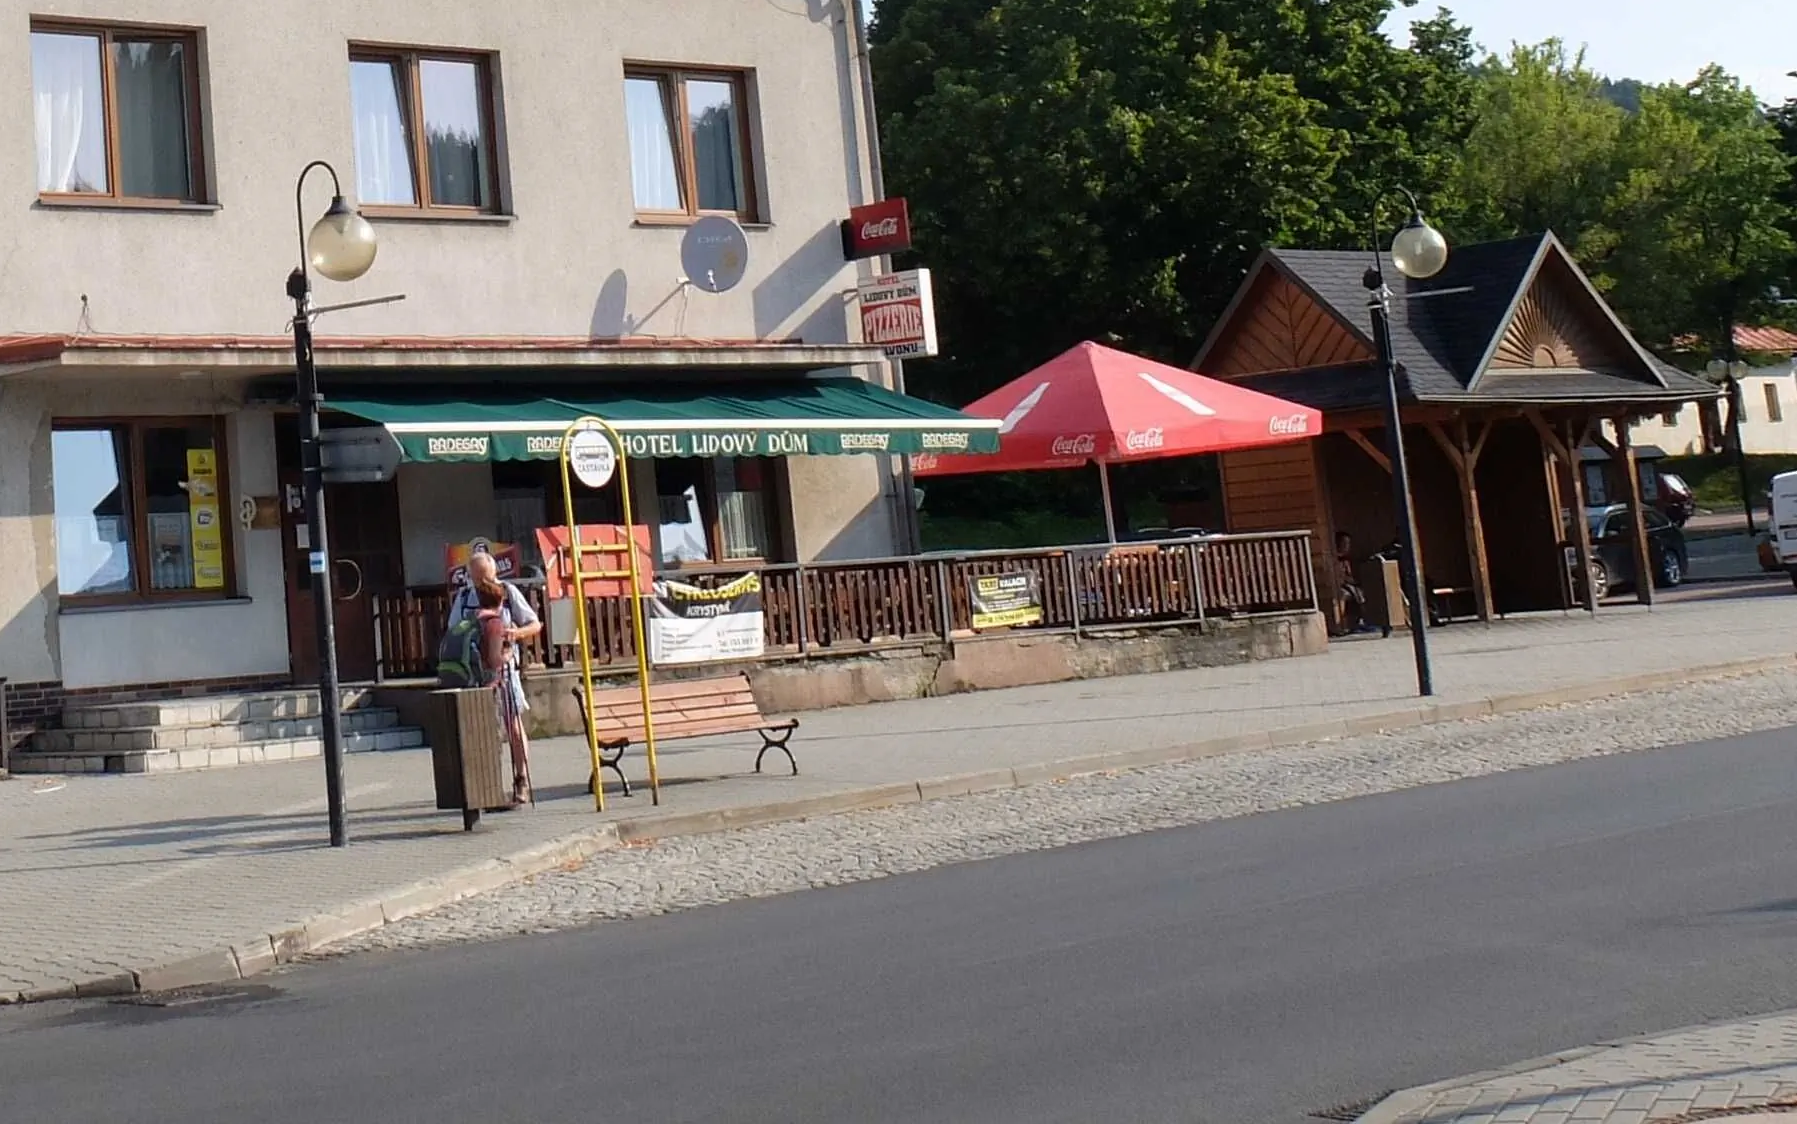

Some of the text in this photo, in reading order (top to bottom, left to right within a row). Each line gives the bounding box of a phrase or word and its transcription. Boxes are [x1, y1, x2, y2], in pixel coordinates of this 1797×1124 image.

[864, 304, 923, 343] PIZZERIE
[620, 429, 808, 454] HOTEL LIDOVÝ DŮM
